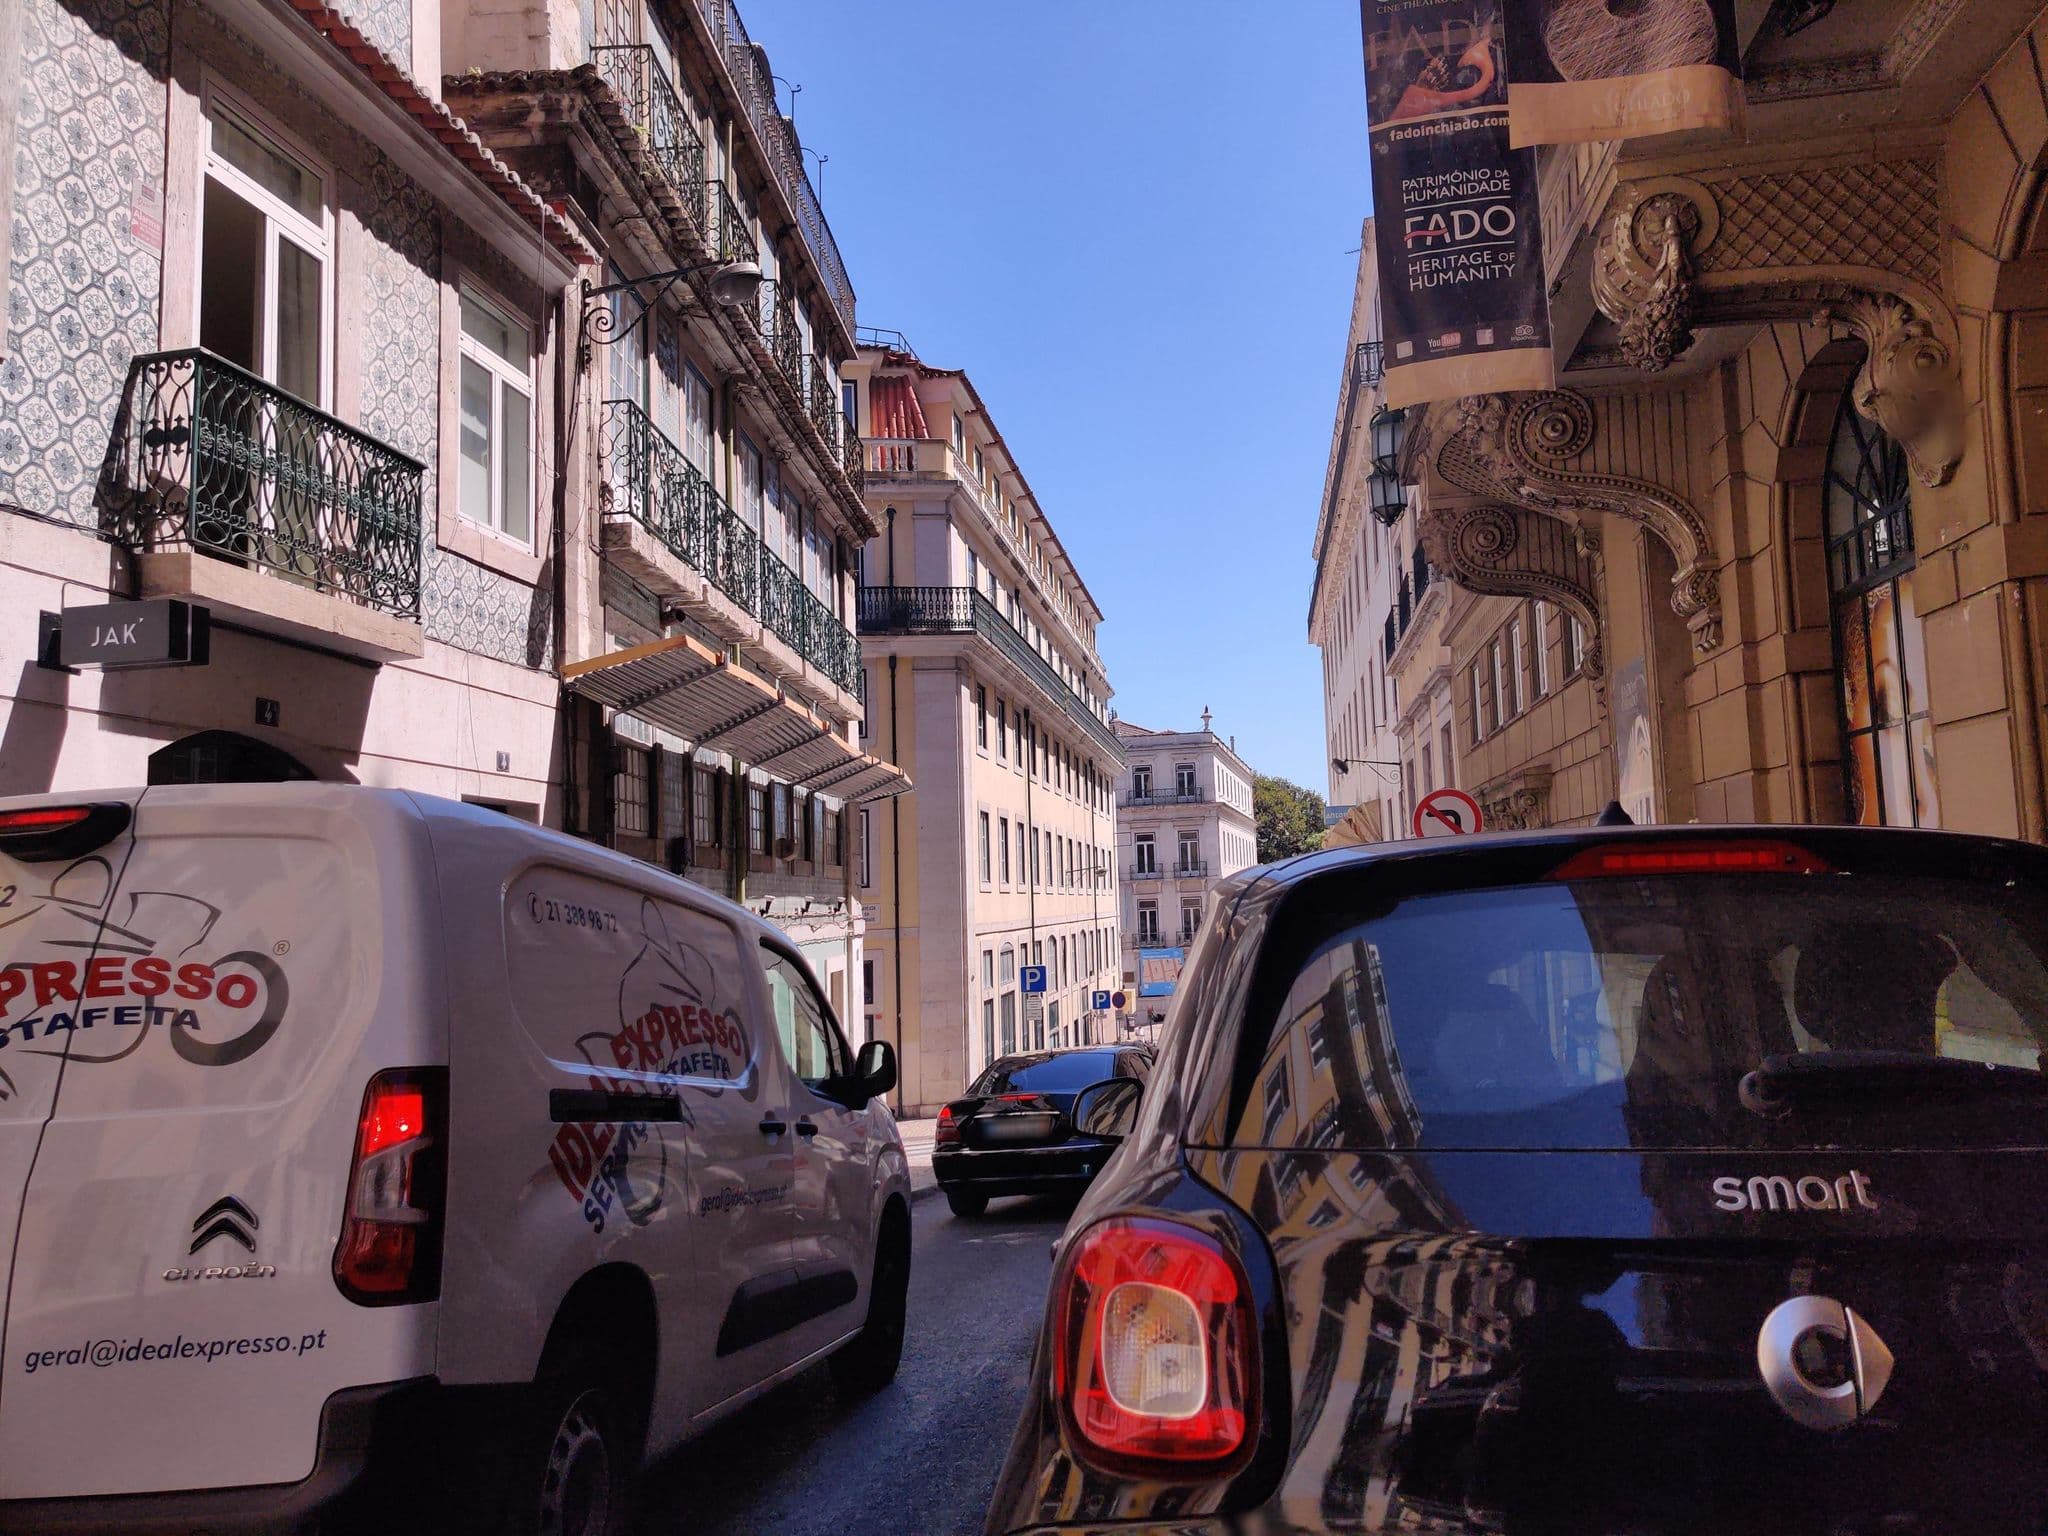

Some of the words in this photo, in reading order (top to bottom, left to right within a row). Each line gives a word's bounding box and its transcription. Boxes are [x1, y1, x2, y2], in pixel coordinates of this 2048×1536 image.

[1389, 116, 1510, 141] fadoinchiado.com
[1402, 168, 1490, 191] PATRIMÓNIO
[1494, 169, 1510, 178] DA
[1403, 179, 1511, 204] HUMANIDADE
[1404, 205, 1516, 249] FADO
[1408, 250, 1492, 276] HERITAGE
[1498, 251, 1516, 262] OF
[1409, 263, 1516, 292] HUMANITY
[545, 900, 561, 922] 21
[1025, 968, 1041, 991] P
[1096, 992, 1107, 1009] P
[609, 1004, 743, 1072] EXPRESSO
[1711, 1169, 1878, 1212] smart
[24, 1329, 327, 1373] geral@idealexpresso.pt
